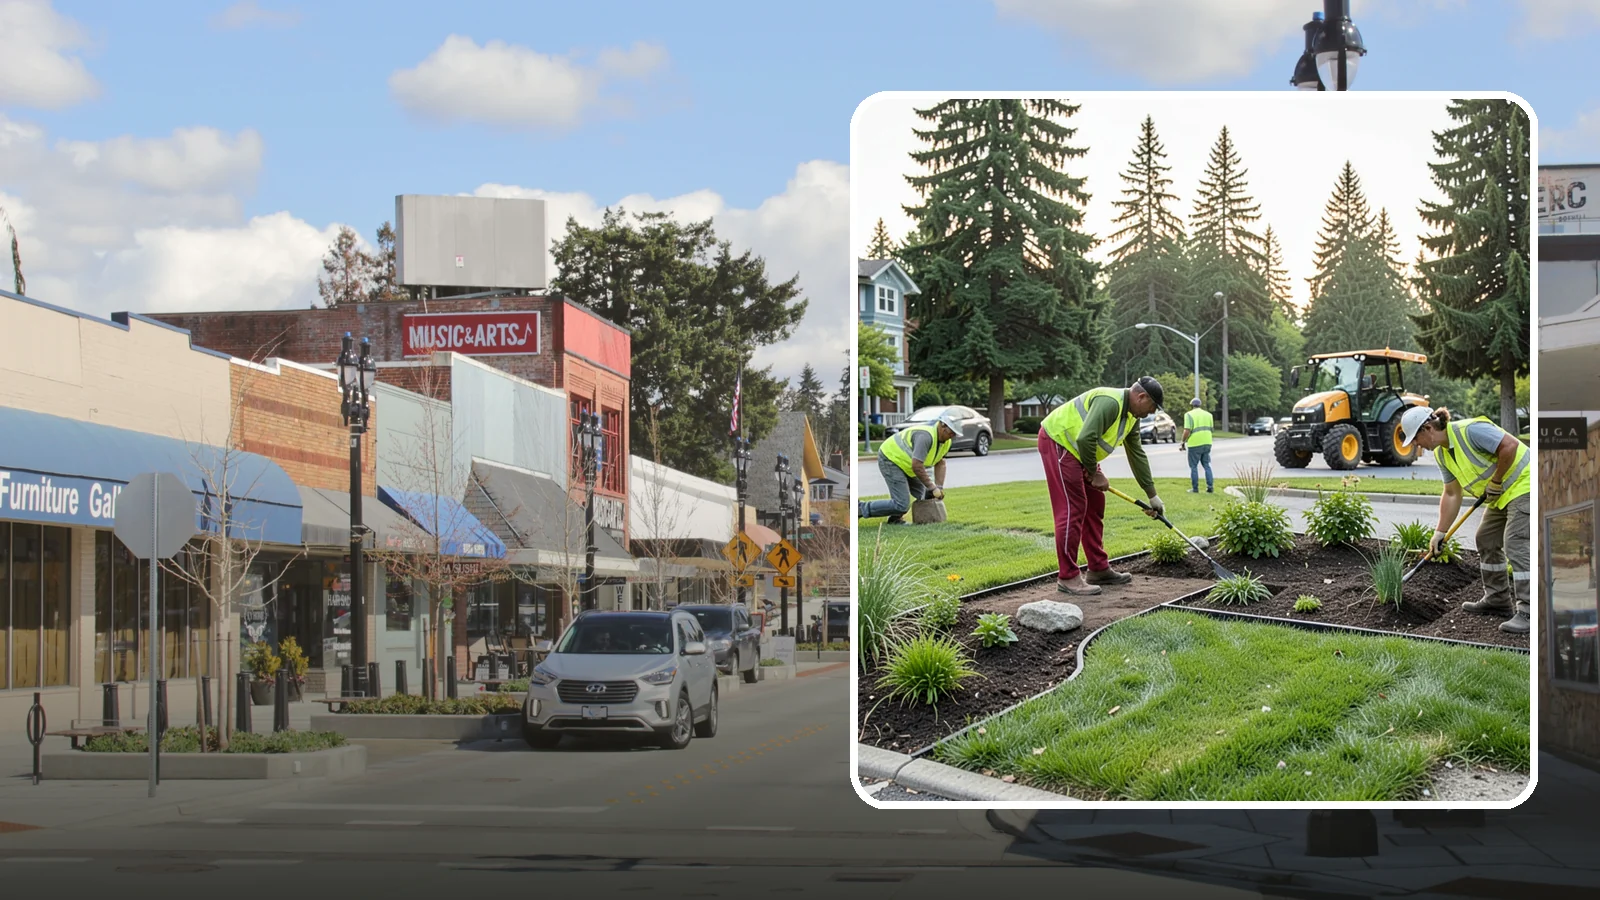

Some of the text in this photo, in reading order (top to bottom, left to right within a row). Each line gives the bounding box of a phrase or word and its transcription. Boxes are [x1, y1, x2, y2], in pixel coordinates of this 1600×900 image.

[0, 471, 122, 519] Furniture Gal
[453, 563, 479, 574] SUSHI
